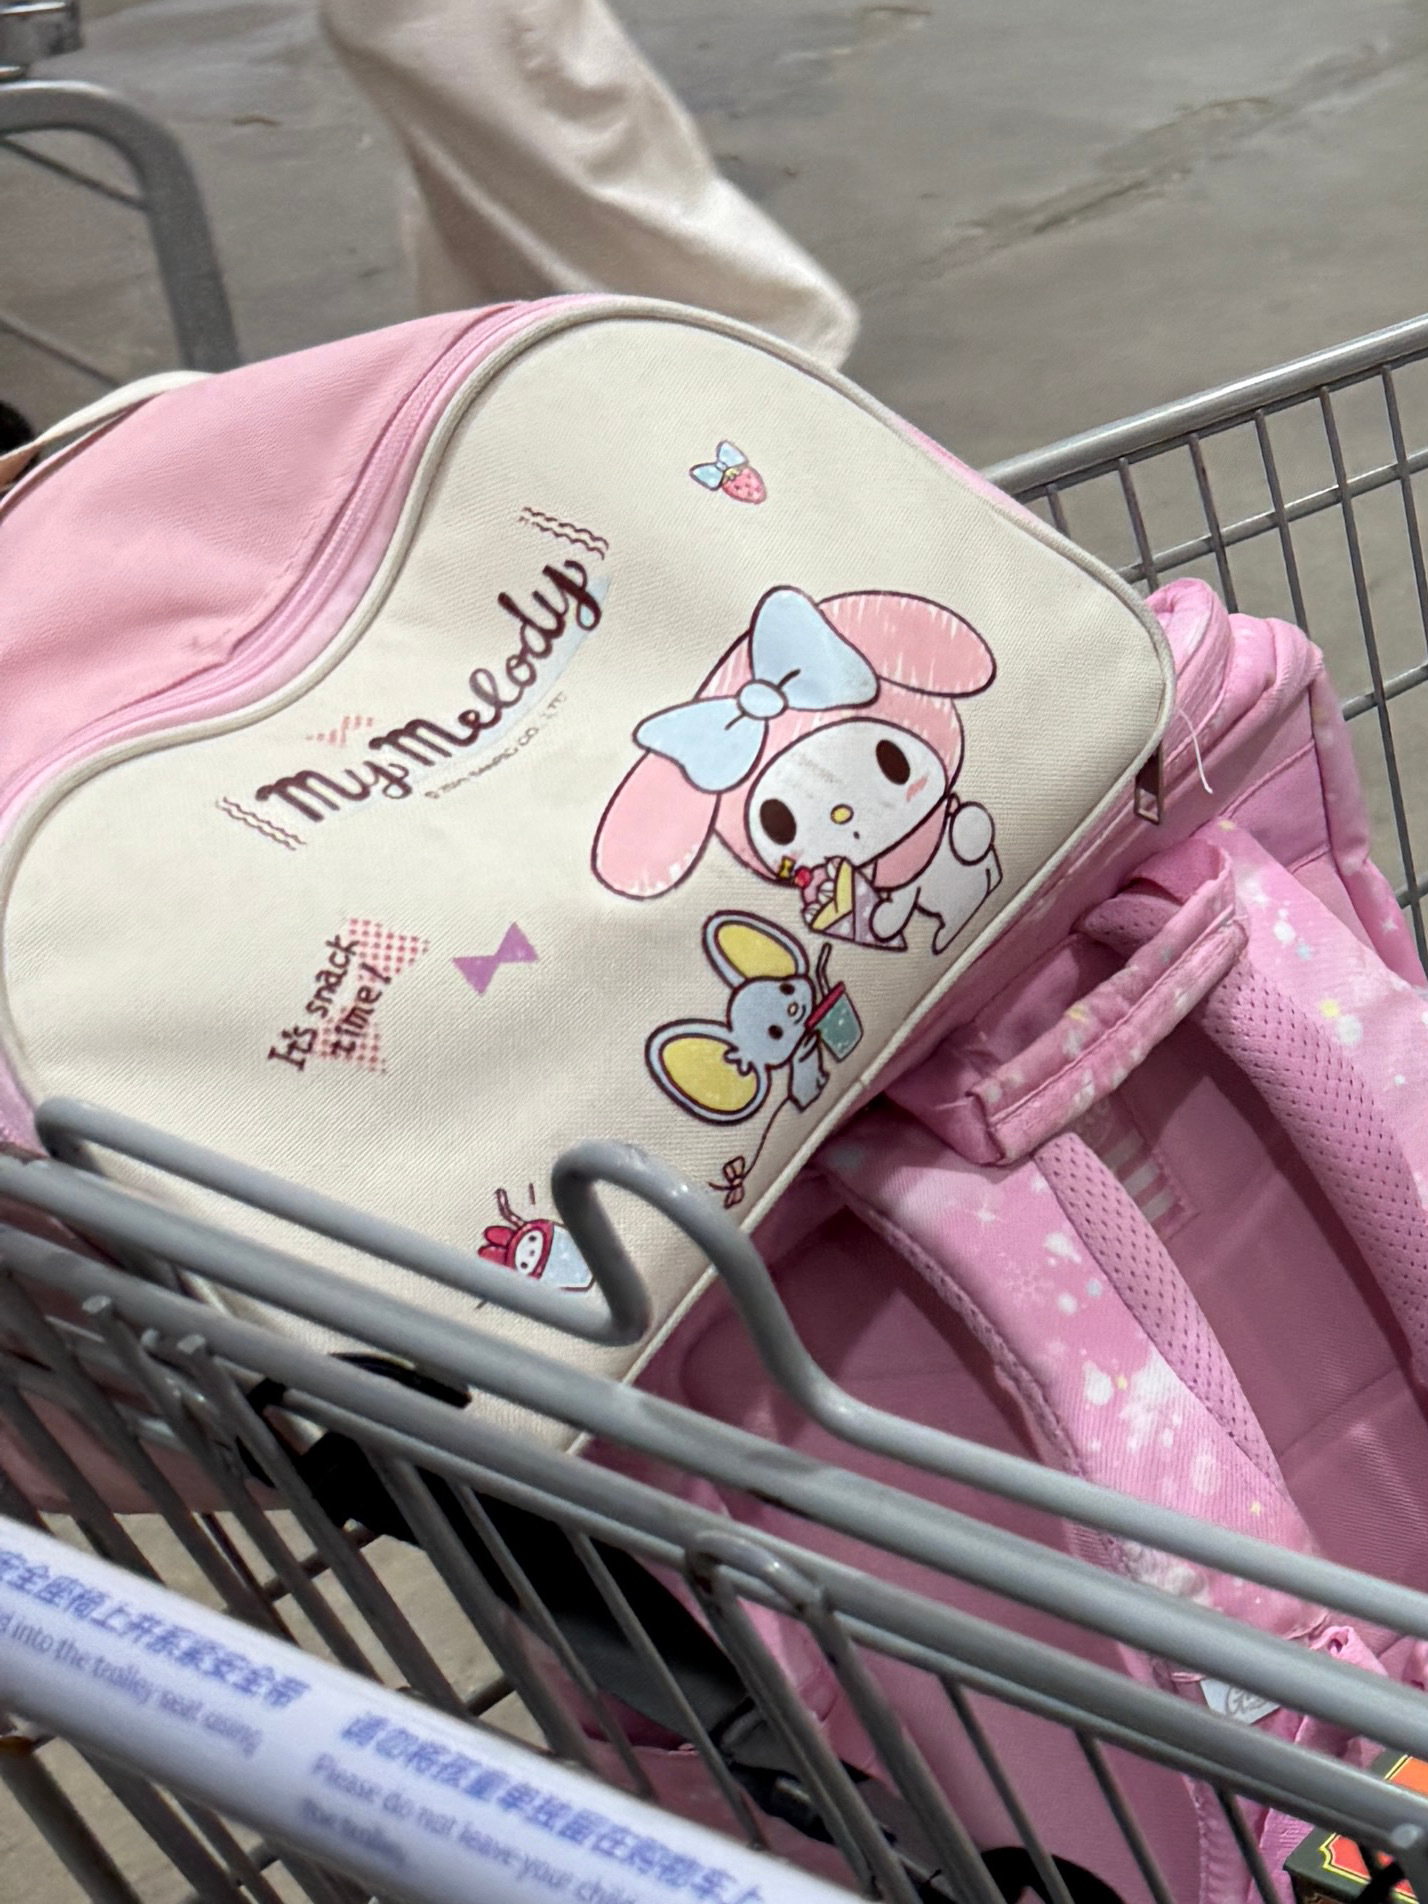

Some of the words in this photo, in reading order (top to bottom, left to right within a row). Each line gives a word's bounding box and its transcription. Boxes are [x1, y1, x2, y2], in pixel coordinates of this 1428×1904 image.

[255, 760, 413, 822] My
[368, 559, 603, 767] Melody
[268, 1026, 318, 1072] It's
[306, 933, 360, 1019] snack
[331, 963, 392, 1057] time!
